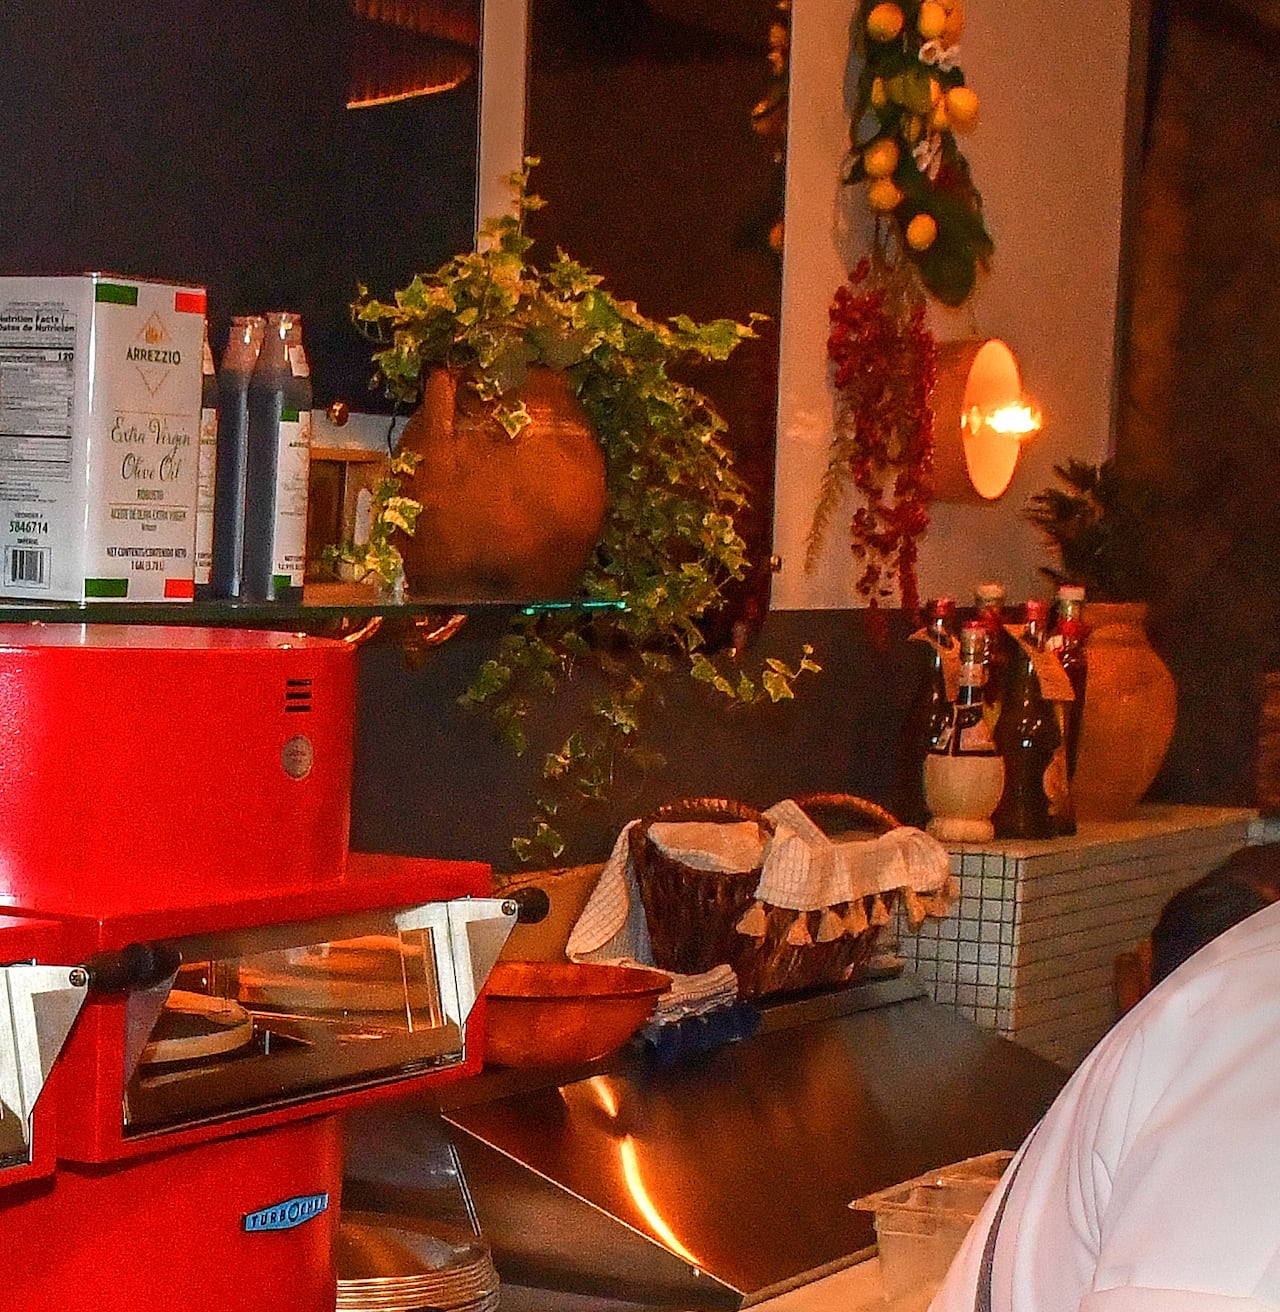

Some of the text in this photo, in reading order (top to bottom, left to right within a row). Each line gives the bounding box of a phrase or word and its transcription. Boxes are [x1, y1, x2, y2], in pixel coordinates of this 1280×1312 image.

[126, 347, 181, 365] ARREZZIO
[111, 416, 190, 457] Extra Virgin
[122, 453, 154, 480] Olive
[9, 521, 48, 534] 5846714
